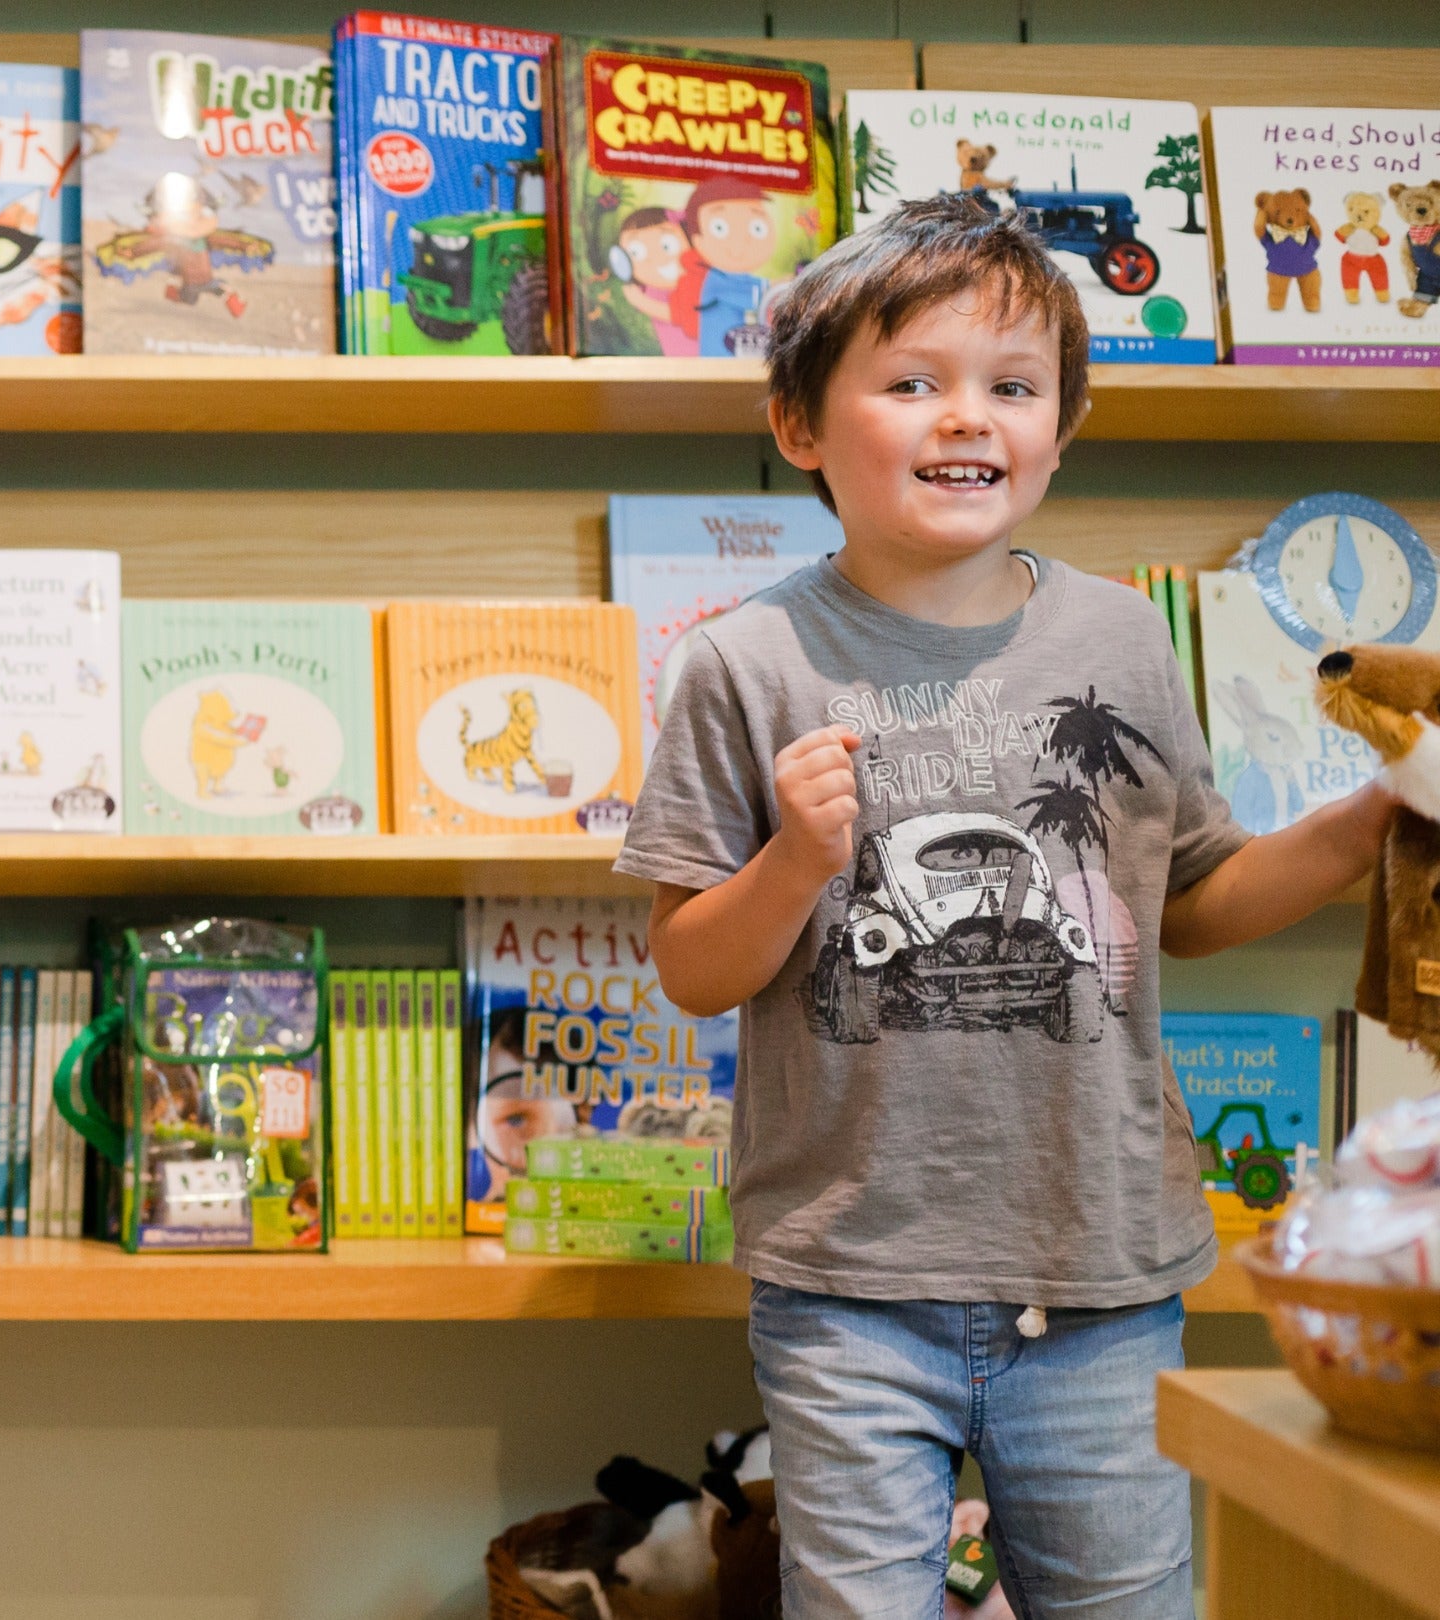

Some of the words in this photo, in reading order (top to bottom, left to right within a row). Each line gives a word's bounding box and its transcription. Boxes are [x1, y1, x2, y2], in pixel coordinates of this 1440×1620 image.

[155, 56, 334, 132] Wildlif
[378, 39, 541, 110] TRACTO
[612, 63, 787, 125] CREEPY
[200, 107, 318, 157] Jack
[373, 95, 419, 129] AND
[423, 99, 527, 146] TRUCKS
[595, 107, 808, 164] CRAWLIES
[909, 103, 957, 129] Old
[973, 107, 1131, 132] Macdonald
[1263, 122, 1342, 149] Head,
[1349, 121, 1440, 147] Should
[369, 148, 428, 175] 1000
[1375, 152, 1420, 173] and
[700, 516, 784, 536] Winnie
[139, 643, 242, 682] Pooh's
[254, 642, 336, 683] Party
[827, 679, 1003, 737] SUNNY
[953, 711, 1060, 758] DAY
[863, 752, 996, 805] RIDE
[494, 920, 650, 968] Activ
[528, 968, 659, 1015] ROCK
[523, 1010, 713, 1069] FOSSIL
[1161, 1039, 1224, 1067] hat's
[1234, 1043, 1277, 1067] not
[521, 1063, 711, 1110] HUNTER
